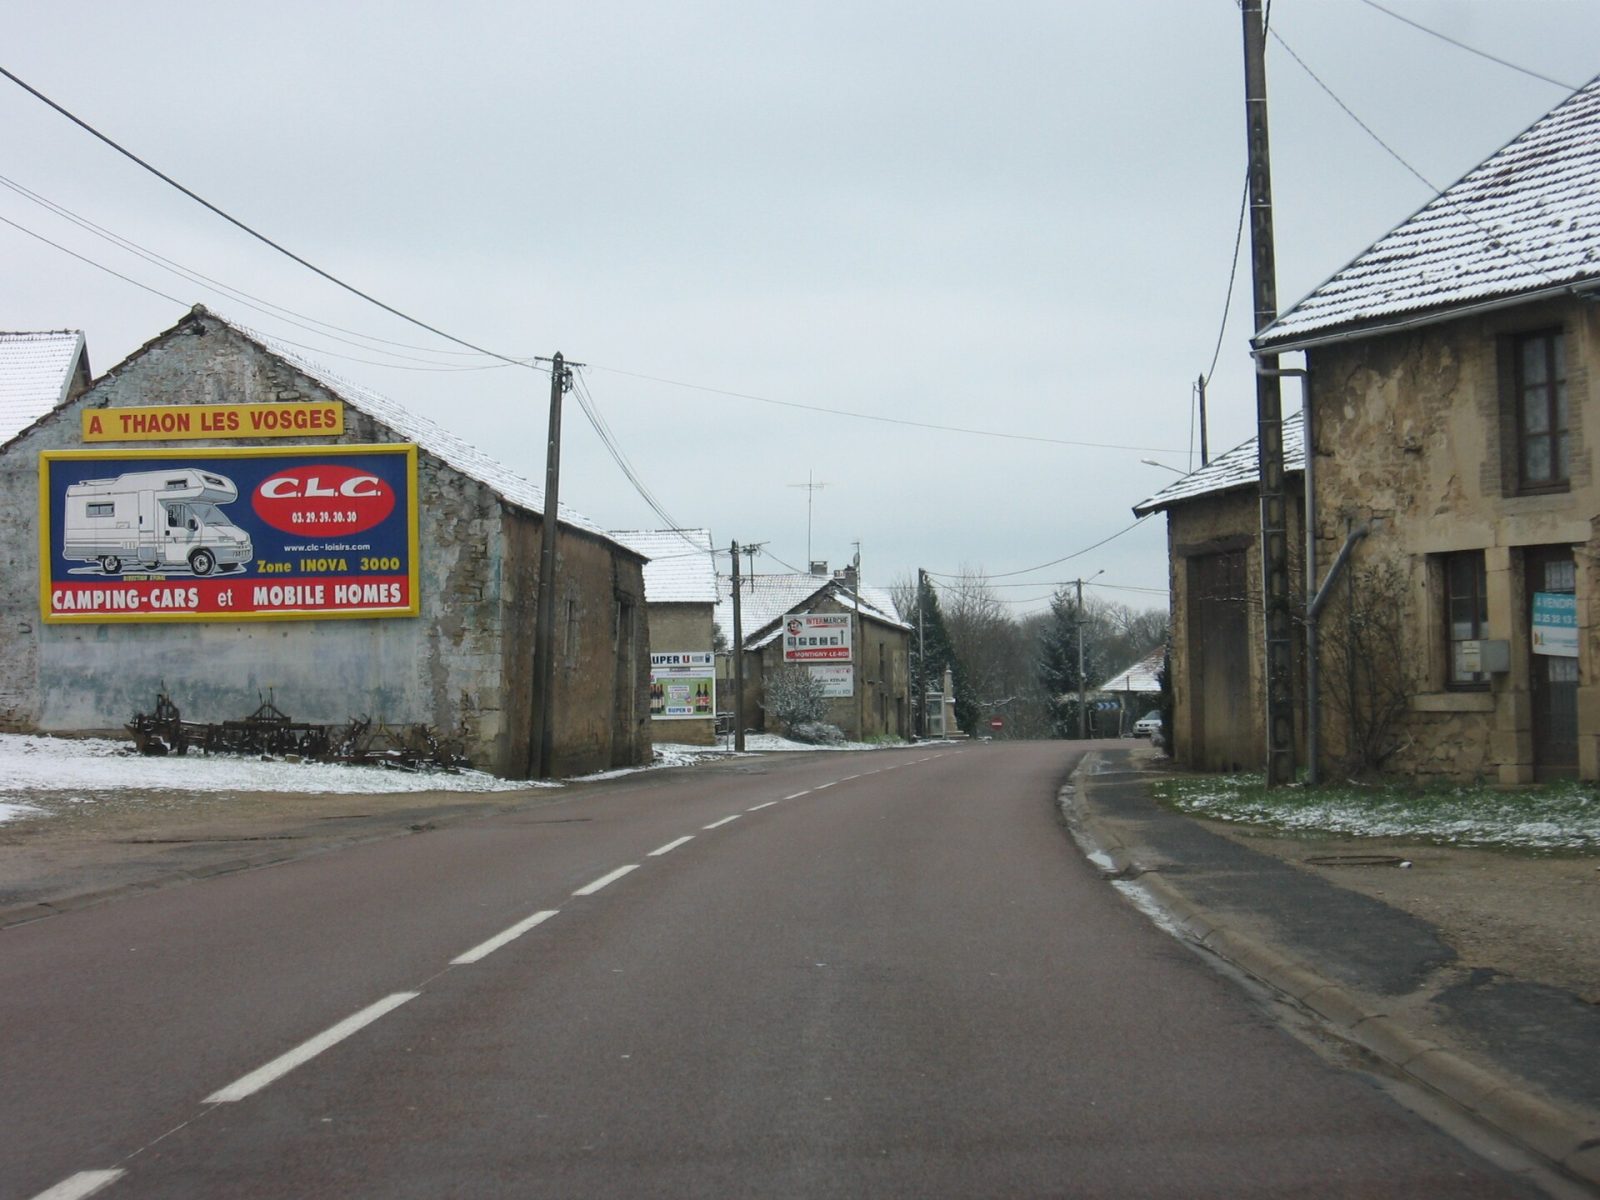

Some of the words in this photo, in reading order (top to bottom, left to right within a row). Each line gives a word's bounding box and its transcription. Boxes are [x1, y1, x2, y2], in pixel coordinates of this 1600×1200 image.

[89, 415, 103, 434] A
[120, 413, 190, 433] THAON
[201, 411, 240, 431] LES
[250, 408, 337, 430] VOSGES
[260, 476, 382, 499] C.L.C.
[284, 543, 371, 552] www.clc-loisirs.com
[257, 559, 292, 574] Zone
[300, 558, 348, 572] INOVA
[360, 557, 401, 571] 3000
[52, 587, 200, 610] CAMPING-CARS
[217, 592, 233, 606] et
[253, 585, 325, 606] MOBILE
[334, 583, 402, 604] HOMES
[1543, 597, 1577, 609] VENDR
[652, 655, 680, 664] UPER
[682, 655, 690, 663] U
